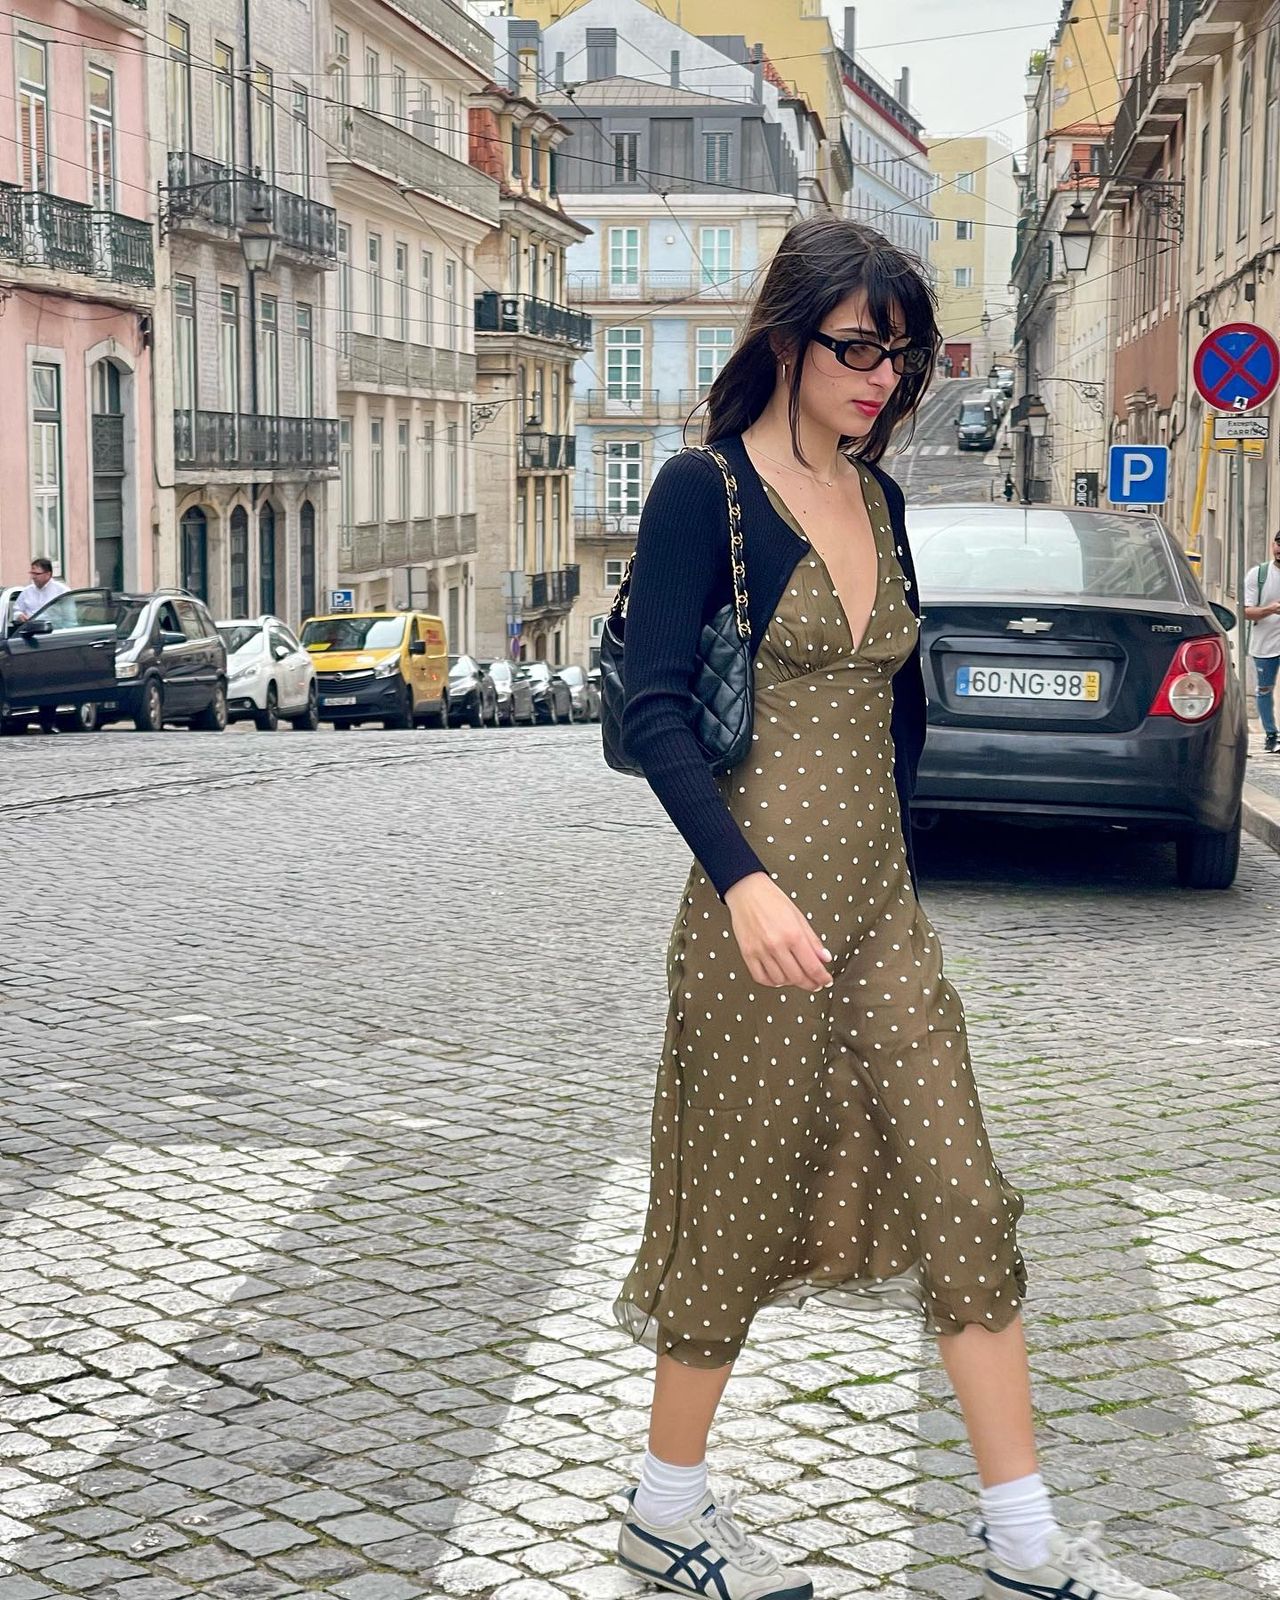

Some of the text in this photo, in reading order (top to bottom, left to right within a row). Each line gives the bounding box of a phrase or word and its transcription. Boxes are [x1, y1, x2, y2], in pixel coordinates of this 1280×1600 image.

[1122, 453, 1154, 497] P
[1151, 624, 1182, 633] AVEO
[1087, 674, 1097, 683] 12
